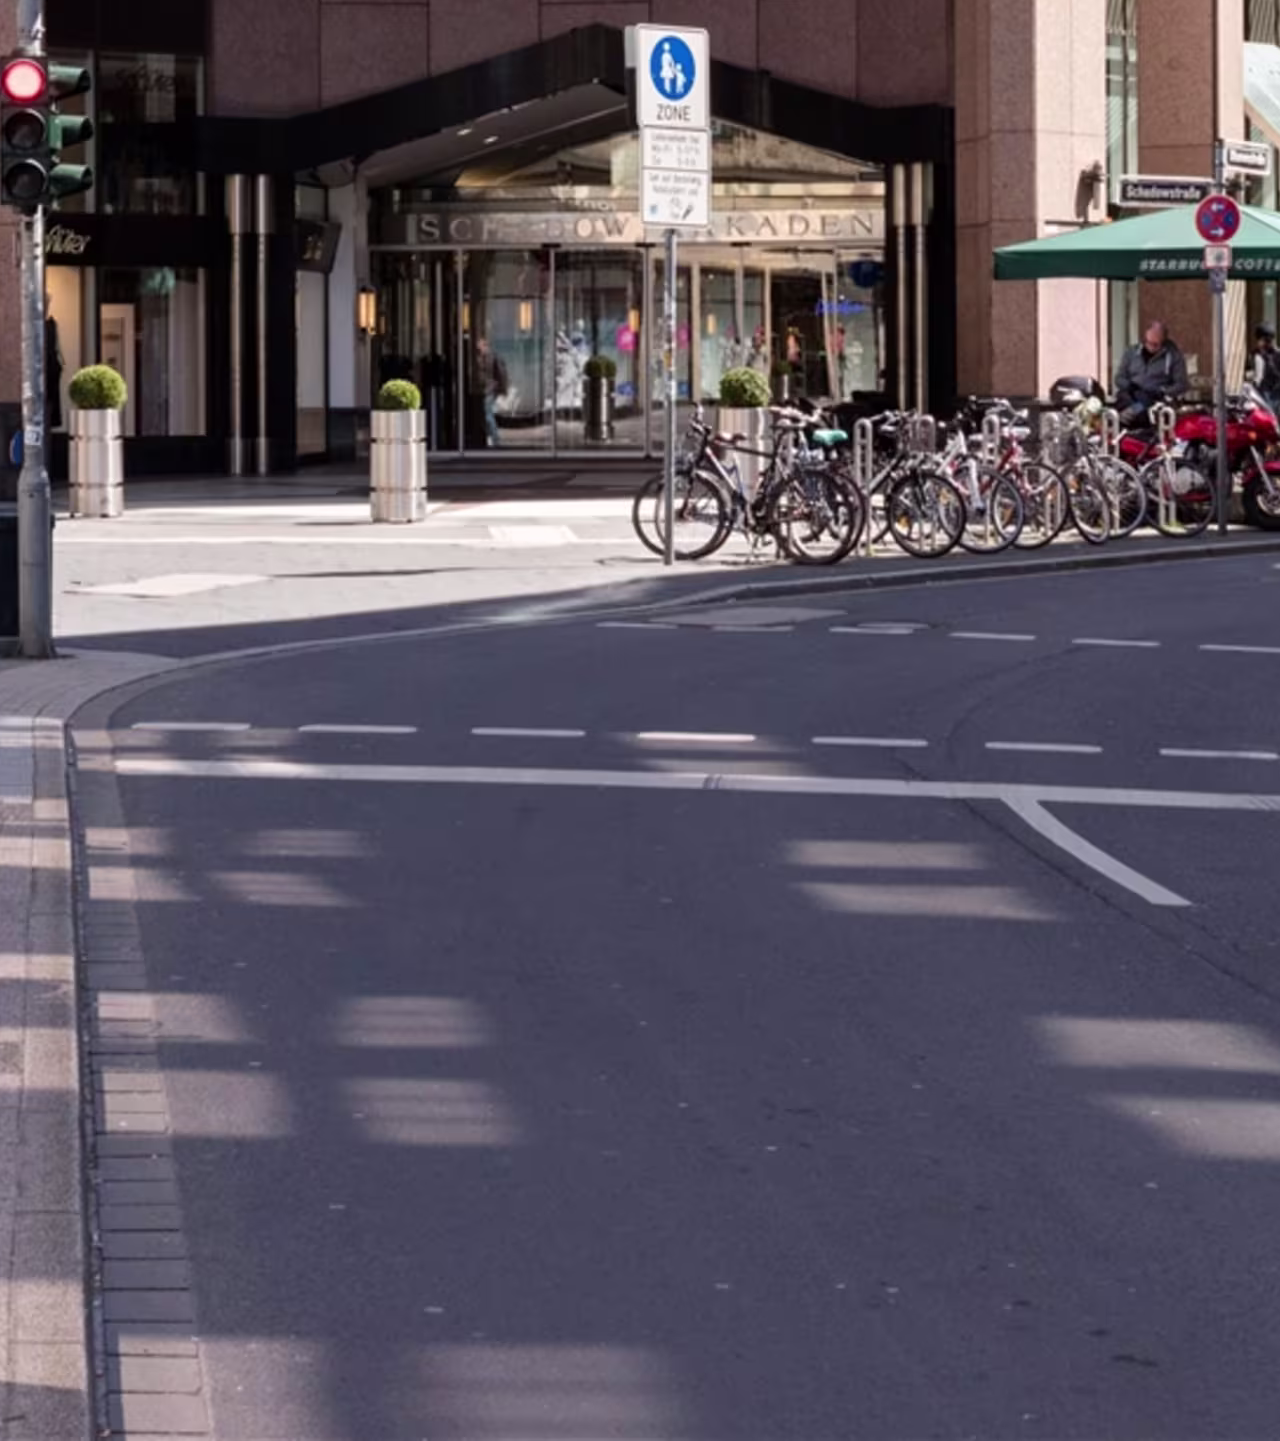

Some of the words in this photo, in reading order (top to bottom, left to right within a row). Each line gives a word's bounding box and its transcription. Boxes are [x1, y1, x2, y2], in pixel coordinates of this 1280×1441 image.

[656, 104, 691, 121] ZONE
[420, 217, 629, 241] SCHDOW
[664, 214, 875, 238] KADEN
[1139, 258, 1206, 272] STARBU
